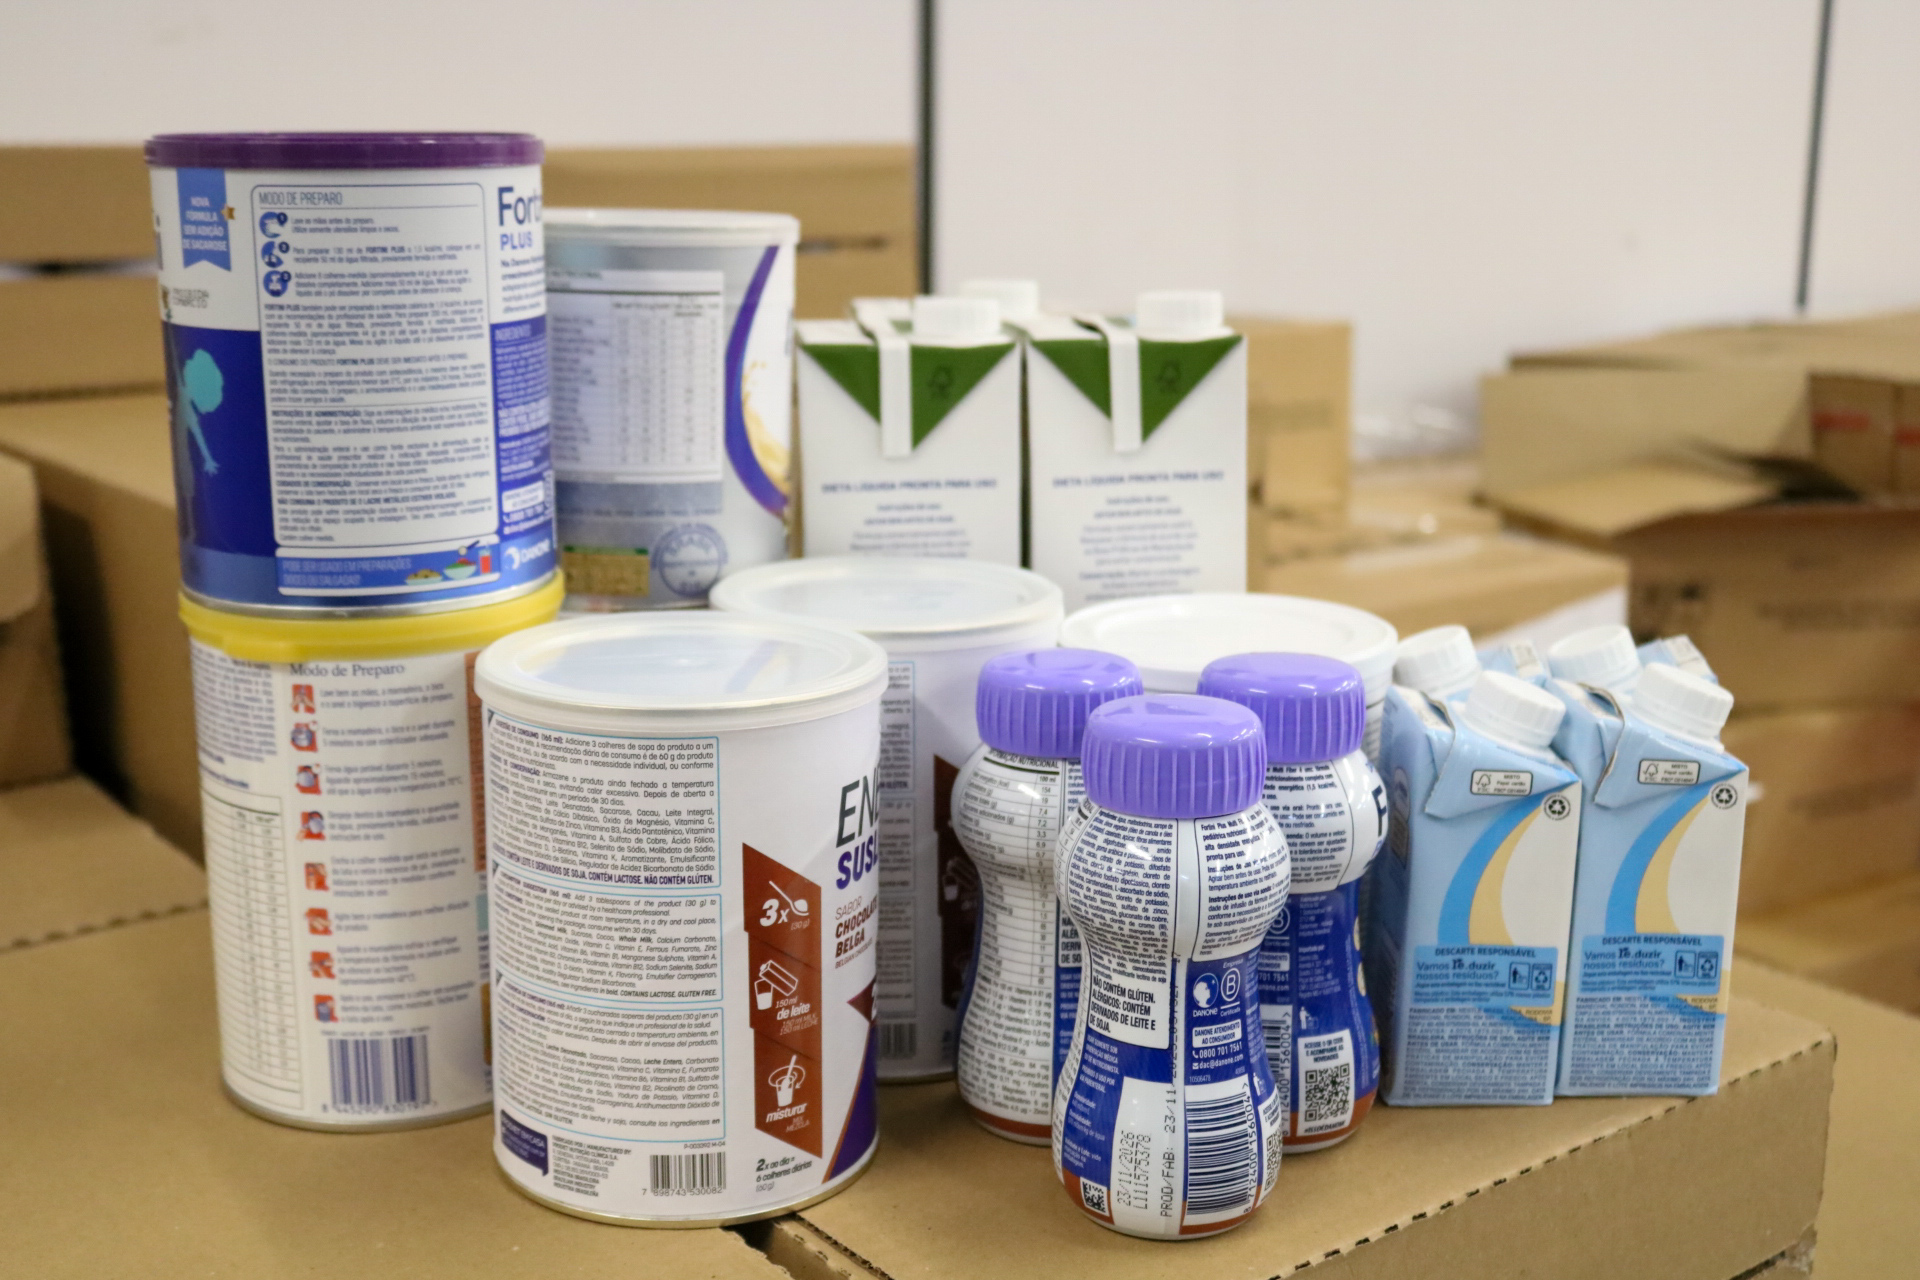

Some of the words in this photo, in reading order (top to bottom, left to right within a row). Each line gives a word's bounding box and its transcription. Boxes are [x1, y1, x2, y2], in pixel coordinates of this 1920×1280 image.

[301, 192, 343, 205] PREPARO
[501, 232, 533, 250] PLUS
[290, 664, 328, 676] Modo
[332, 664, 346, 676] de
[352, 664, 405, 678] Preparo
[668, 743, 694, 751] produto
[589, 871, 612, 882] CONTÉM
[614, 874, 643, 884] LACTOSE.
[644, 875, 657, 884] NÃO
[659, 873, 685, 885] CONTÉM
[687, 873, 713, 884] GLÚTEN.
[835, 896, 862, 920] SABOR
[835, 928, 865, 958] BELGA
[1602, 936, 1642, 945] DESCARTE
[1644, 936, 1702, 946] RESPONSÁVEL
[1435, 947, 1475, 956] DESCARTE
[1477, 947, 1536, 958] RESPONSÁVEL
[1584, 952, 1616, 960] Vamos
[1417, 962, 1450, 971] Vamos
[1584, 961, 1616, 969] nossos
[1619, 960, 1665, 969] resíduos?
[1416, 971, 1449, 980] nossos
[1452, 971, 1499, 980] resíduos?
[1093, 976, 1102, 988] NÃO
[1103, 980, 1126, 997] CONTÉM
[1128, 989, 1155, 1003] GLÚTEN.
[1226, 974, 1236, 995] B
[776, 998, 789, 1008] 150
[790, 996, 797, 1005] ml
[1092, 989, 1121, 1009] ALÉRGICOS:
[1122, 1001, 1150, 1016] CONTÉM
[777, 1009, 789, 1020] de
[791, 1003, 810, 1017] leite
[1091, 1001, 1119, 1022] DERIVADOS
[1121, 1014, 1128, 1026] DE
[1131, 1018, 1149, 1029] LEITE
[1151, 1020, 1155, 1030] E
[1090, 1014, 1095, 1026] DE
[1096, 1019, 1110, 1033] SOJA.
[1195, 1028, 1213, 1036] DANONE
[1214, 1021, 1240, 1034] ATENDIMENTO
[1209, 1032, 1235, 1044] CONSUMIDOR
[1199, 1049, 1216, 1058] 0800
[1218, 1046, 1228, 1056] 701
[1230, 1041, 1242, 1053] 7561
[1199, 1053, 1243, 1069] dac@danone.com
[766, 1103, 808, 1123] misturar
[1245, 1095, 1256, 1146] 156004
[763, 1167, 790, 1181] colheres
[1117, 1130, 1134, 1206] 23/11/2026
[1160, 1147, 1175, 1217] PROD/FAB:
[1247, 1153, 1257, 1200] 712400
[690, 1187, 722, 1195] 530082
